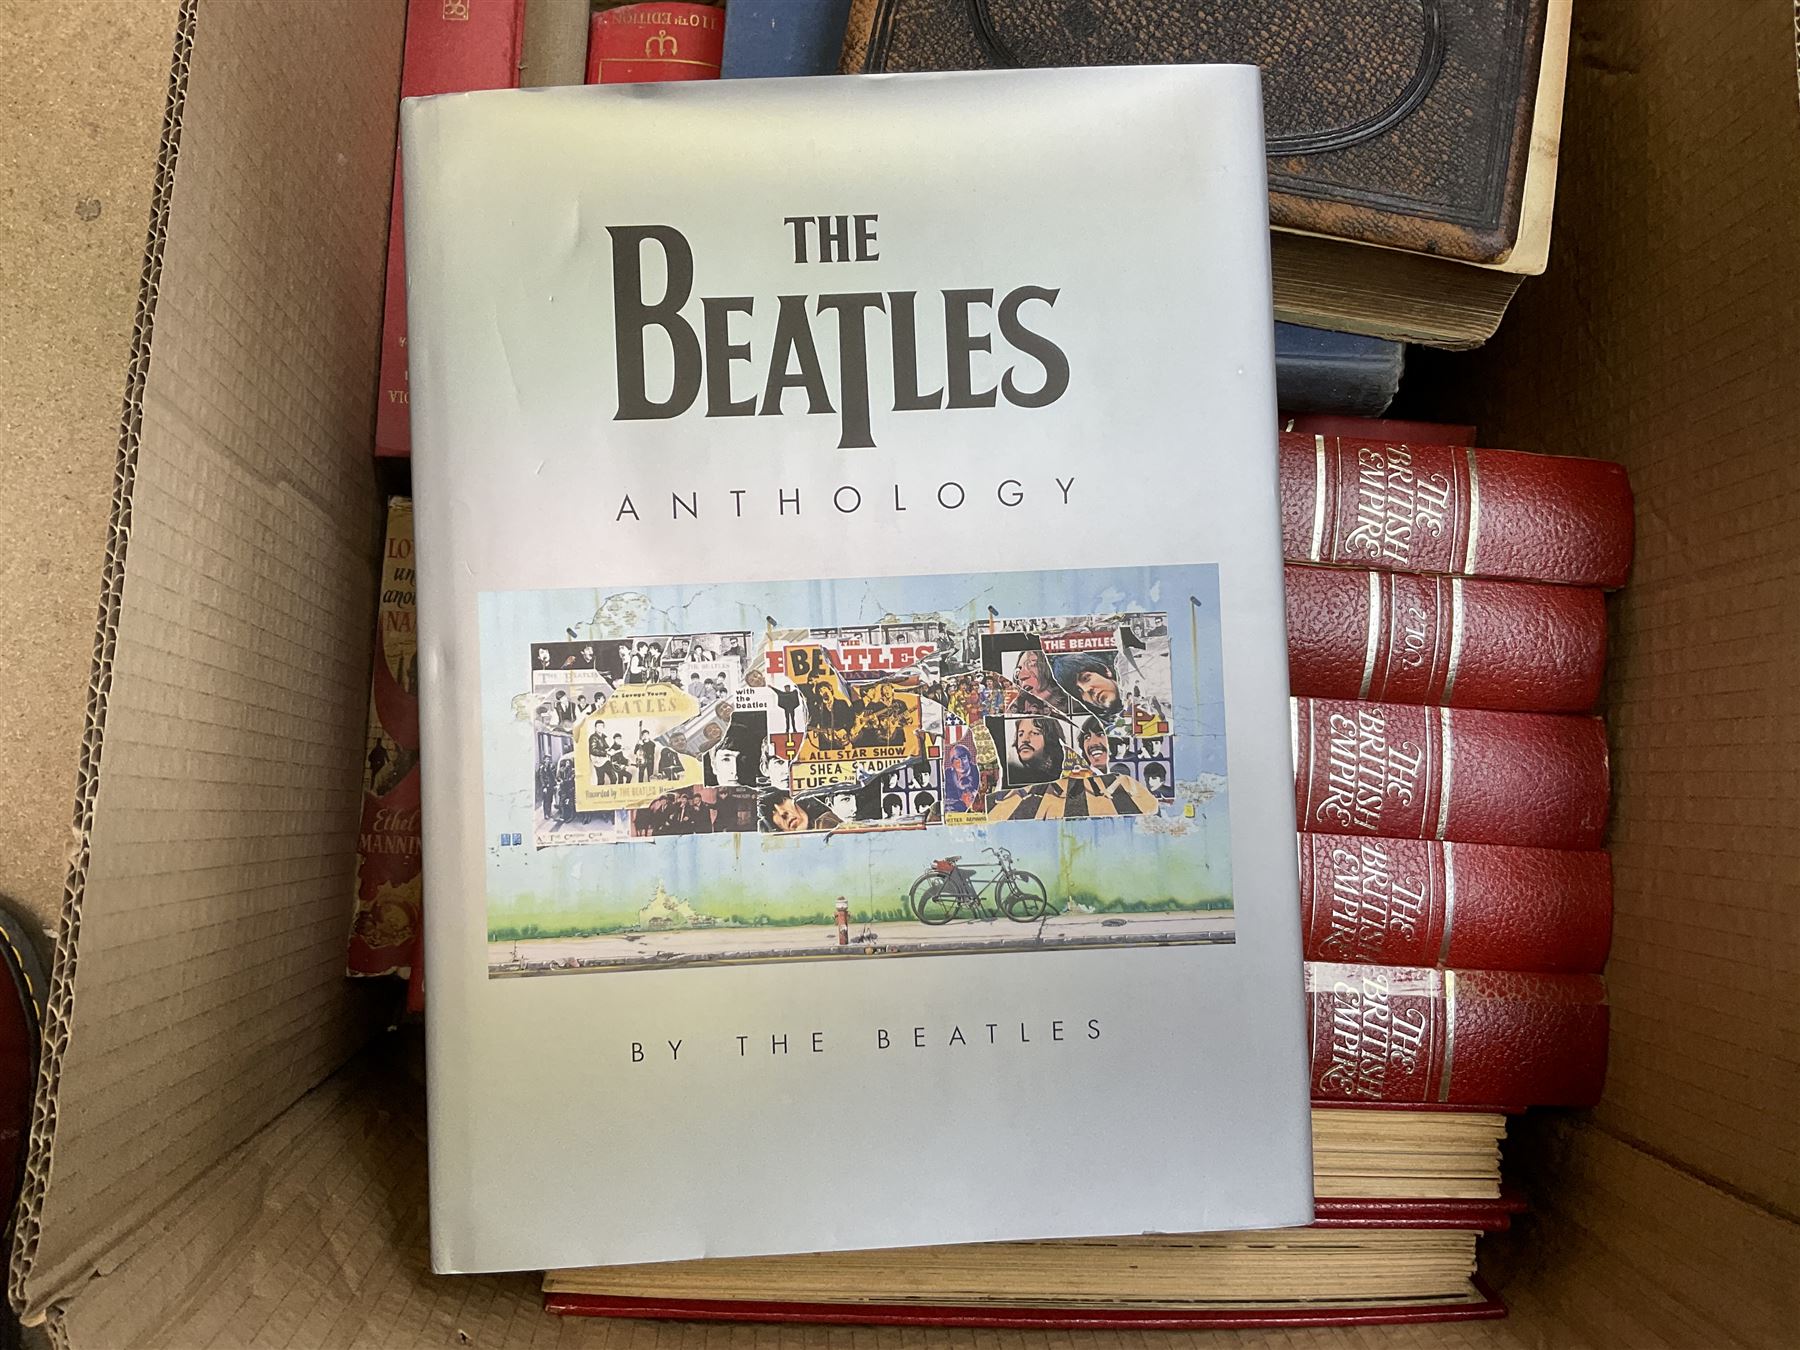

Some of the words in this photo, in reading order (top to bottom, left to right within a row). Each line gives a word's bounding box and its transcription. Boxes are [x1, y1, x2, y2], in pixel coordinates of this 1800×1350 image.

[784, 214, 880, 264] THE
[605, 224, 1070, 449] BEATLES
[615, 477, 1075, 522] ANTHOLOGY
[1346, 448, 1386, 558] EMPIRE
[1383, 444, 1413, 564] BRITISH
[1416, 473, 1450, 537] THE
[1044, 639, 1066, 650] THE
[1069, 637, 1116, 649] BEATLES
[1402, 622, 1426, 670] VOL
[809, 751, 831, 760] ALL
[837, 750, 867, 759] STAR
[873, 747, 906, 756] SHOW
[810, 764, 842, 775] SHEA
[1316, 714, 1357, 827] EMPIRE
[1354, 708, 1386, 830] BRITISH
[1387, 741, 1422, 807] THE
[1318, 848, 1360, 960] EMPIRE
[1355, 842, 1389, 963] BRITISH
[1390, 876, 1426, 941] THE
[631, 1039, 683, 1063] BY
[735, 1031, 824, 1057] THE
[876, 1018, 1102, 1050] BEATLES
[1320, 981, 1361, 1096] EMPIRE
[1357, 974, 1389, 1099] BRITISH
[1390, 1008, 1426, 1075] THE
